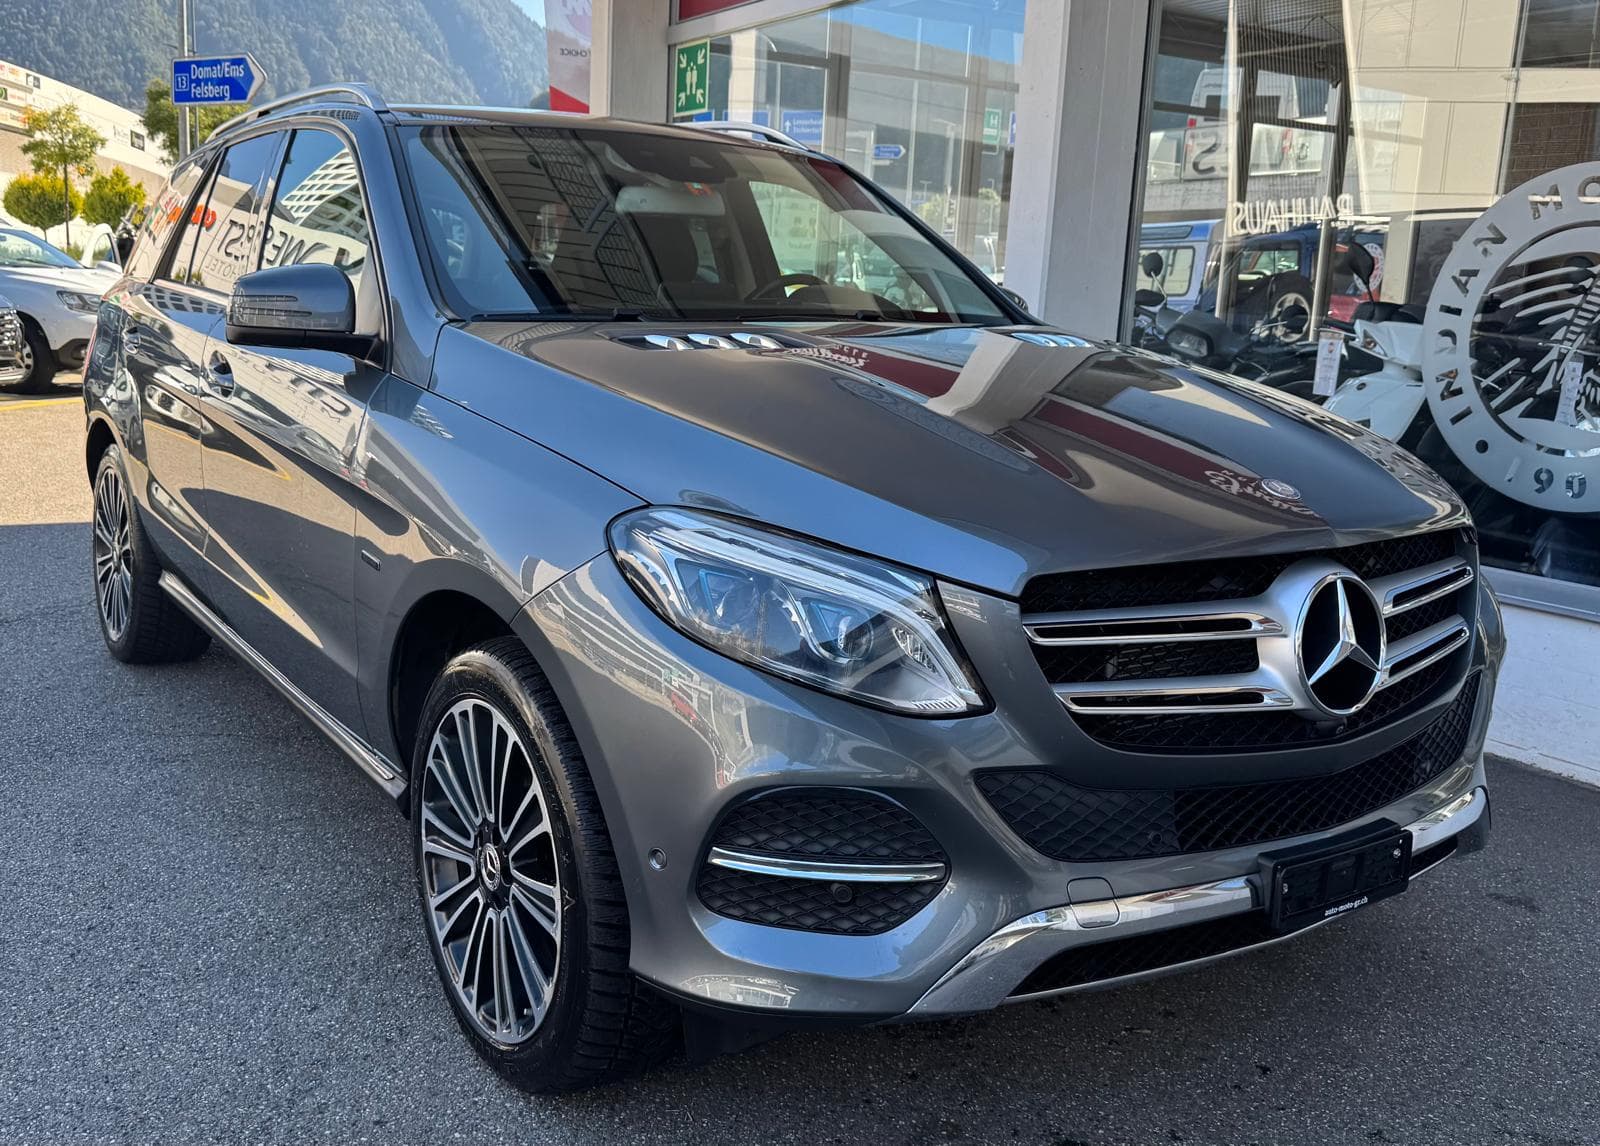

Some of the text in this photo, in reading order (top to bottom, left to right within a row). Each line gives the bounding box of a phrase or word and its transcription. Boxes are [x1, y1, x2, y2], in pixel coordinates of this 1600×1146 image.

[190, 62, 244, 80] Domat/Ems
[177, 76, 187, 89] 13
[190, 82, 230, 101] Felsberg
[1434, 222, 1508, 426] INDIAN
